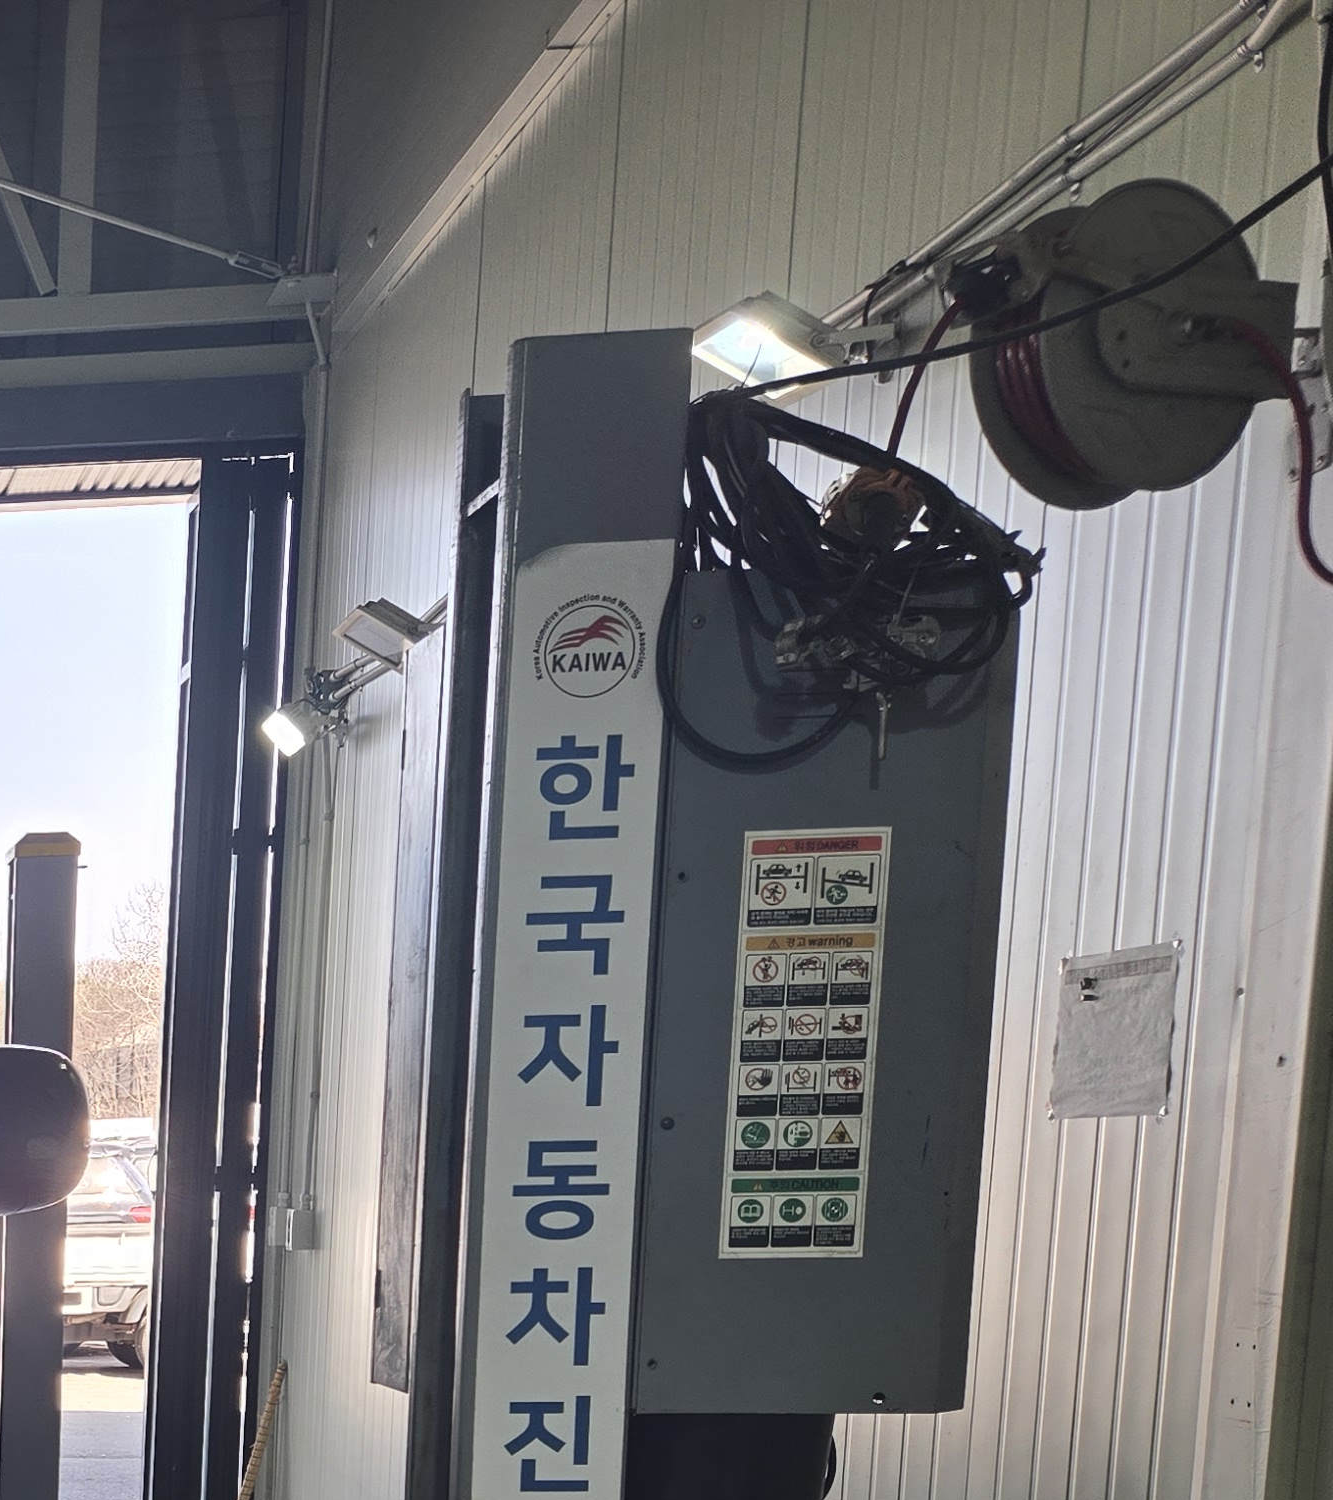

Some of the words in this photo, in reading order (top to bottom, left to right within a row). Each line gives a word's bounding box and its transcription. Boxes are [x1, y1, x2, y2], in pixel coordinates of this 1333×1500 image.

[558, 594, 600, 612] Inspection
[602, 595, 617, 605] and
[617, 599, 643, 630] Warranty
[533, 611, 559, 654] Automotive
[552, 651, 627, 673] KAIWA
[631, 632, 646, 679] Association
[533, 656, 544, 680] Korea
[816, 839, 859, 851] DANGER
[808, 935, 854, 947] warning
[791, 1178, 840, 1190] CAUTION
